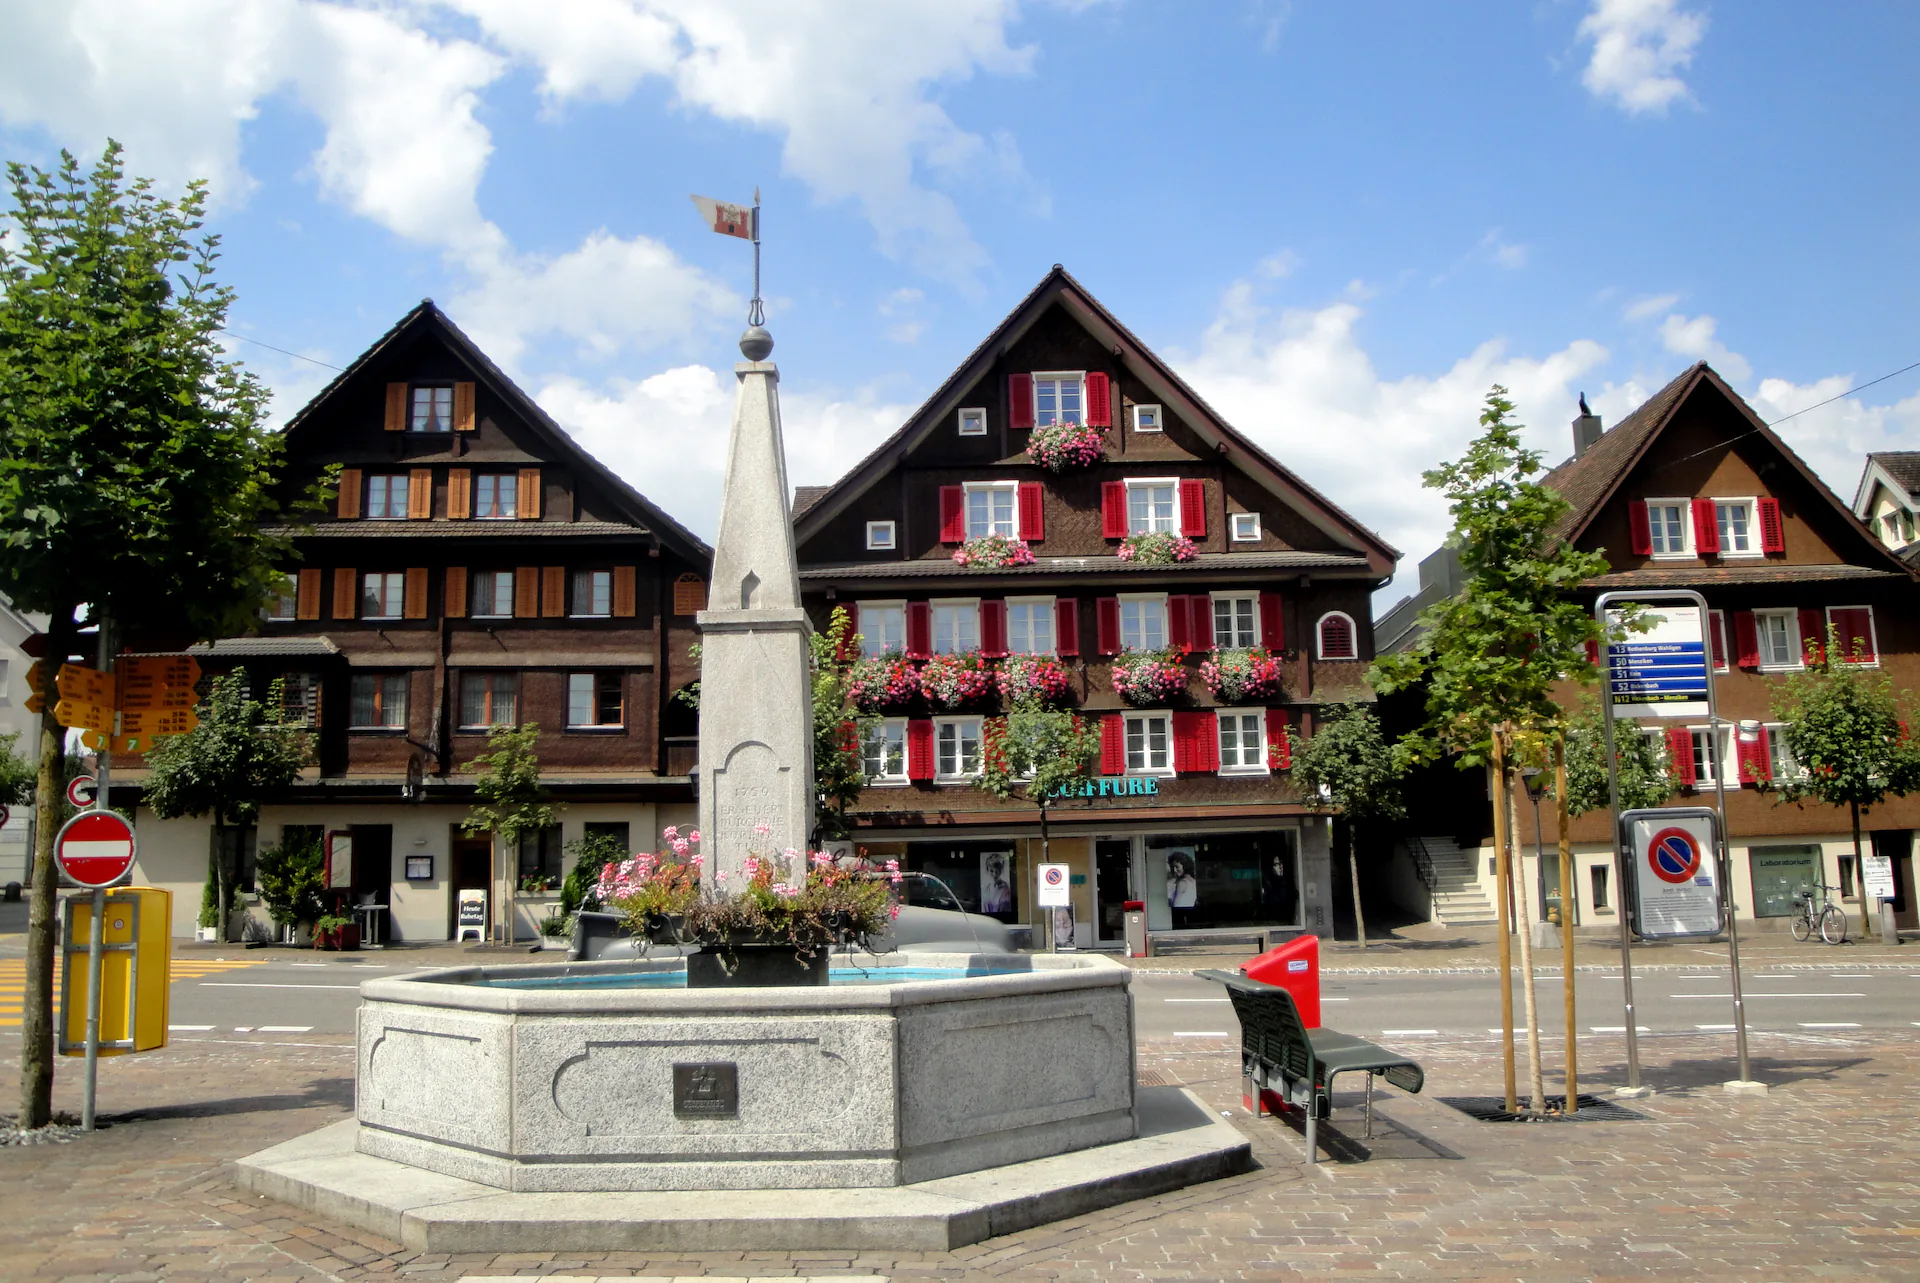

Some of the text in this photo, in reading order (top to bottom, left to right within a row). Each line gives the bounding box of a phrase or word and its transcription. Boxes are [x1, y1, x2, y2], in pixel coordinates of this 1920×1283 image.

[1615, 645, 1626, 654] 13
[1616, 658, 1627, 666] 50
[1616, 670, 1628, 678] 51
[1618, 683, 1629, 691] 52
[1614, 695, 1630, 703] N12
[127, 739, 137, 751] 7
[1760, 858, 1811, 867] Laboratorium
[460, 913, 483, 921] Ruhetag
